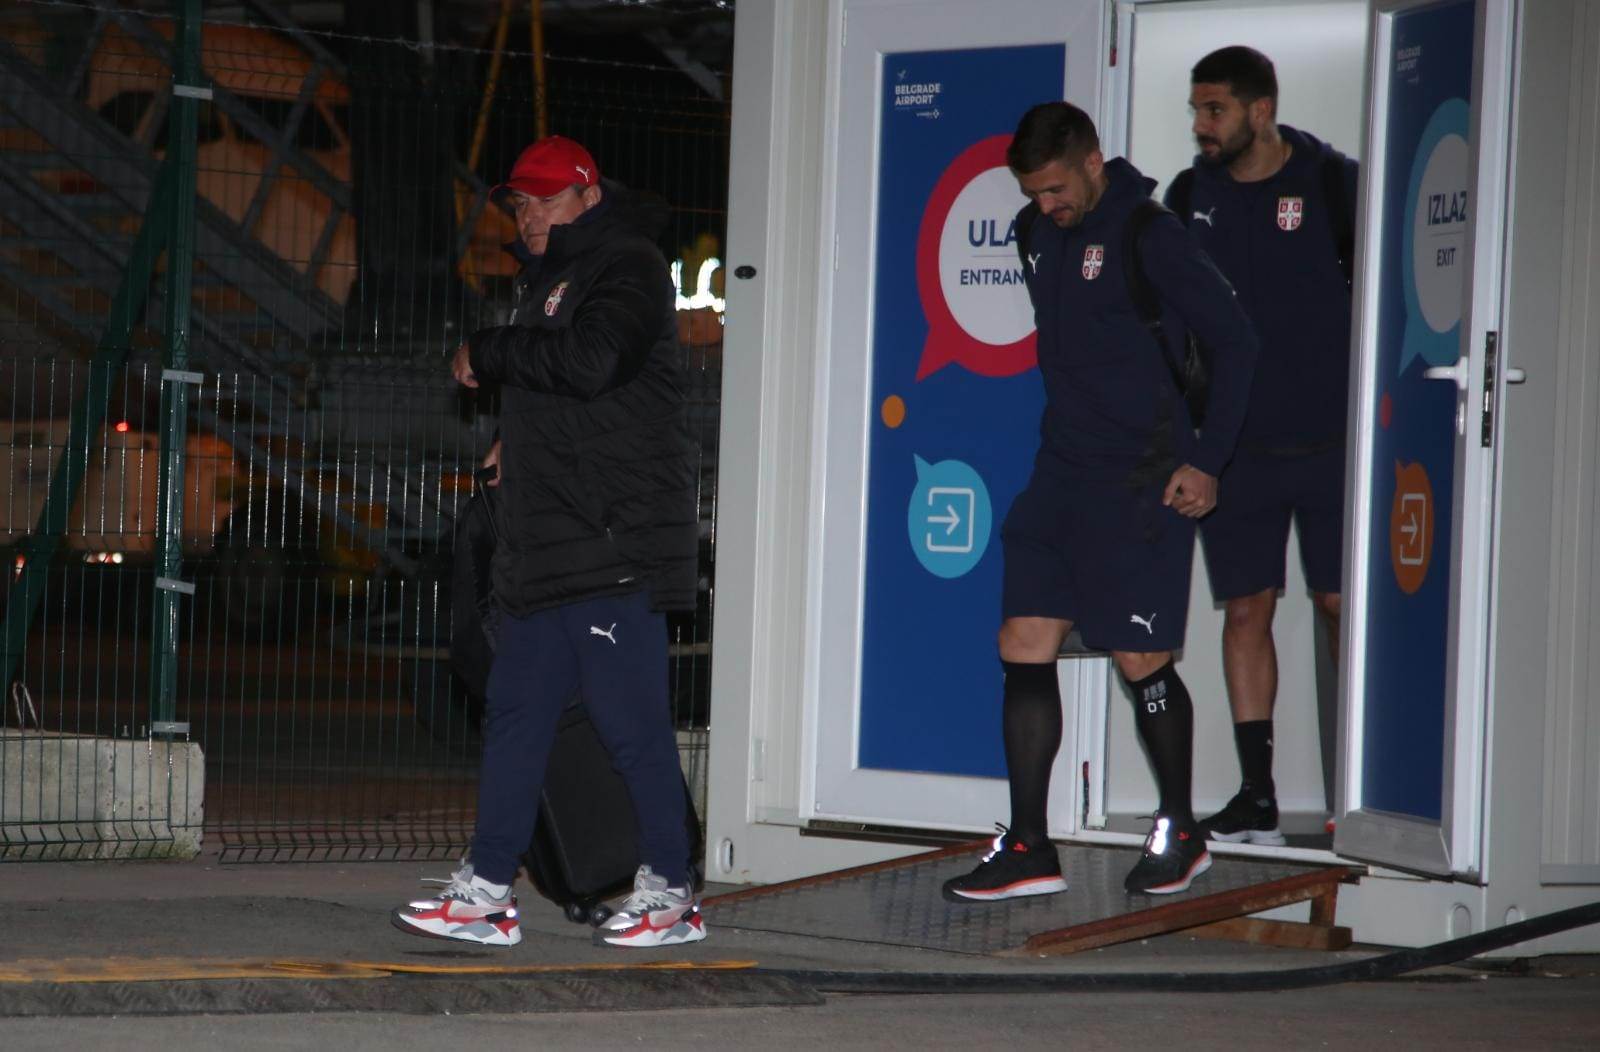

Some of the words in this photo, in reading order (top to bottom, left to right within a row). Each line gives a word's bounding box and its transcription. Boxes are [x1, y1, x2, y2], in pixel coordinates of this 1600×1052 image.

[895, 84, 941, 95] BELGRADE
[895, 95, 934, 105] AIRPORT
[1427, 191, 1467, 226] IZLAZ
[1436, 248, 1456, 267] EXIT
